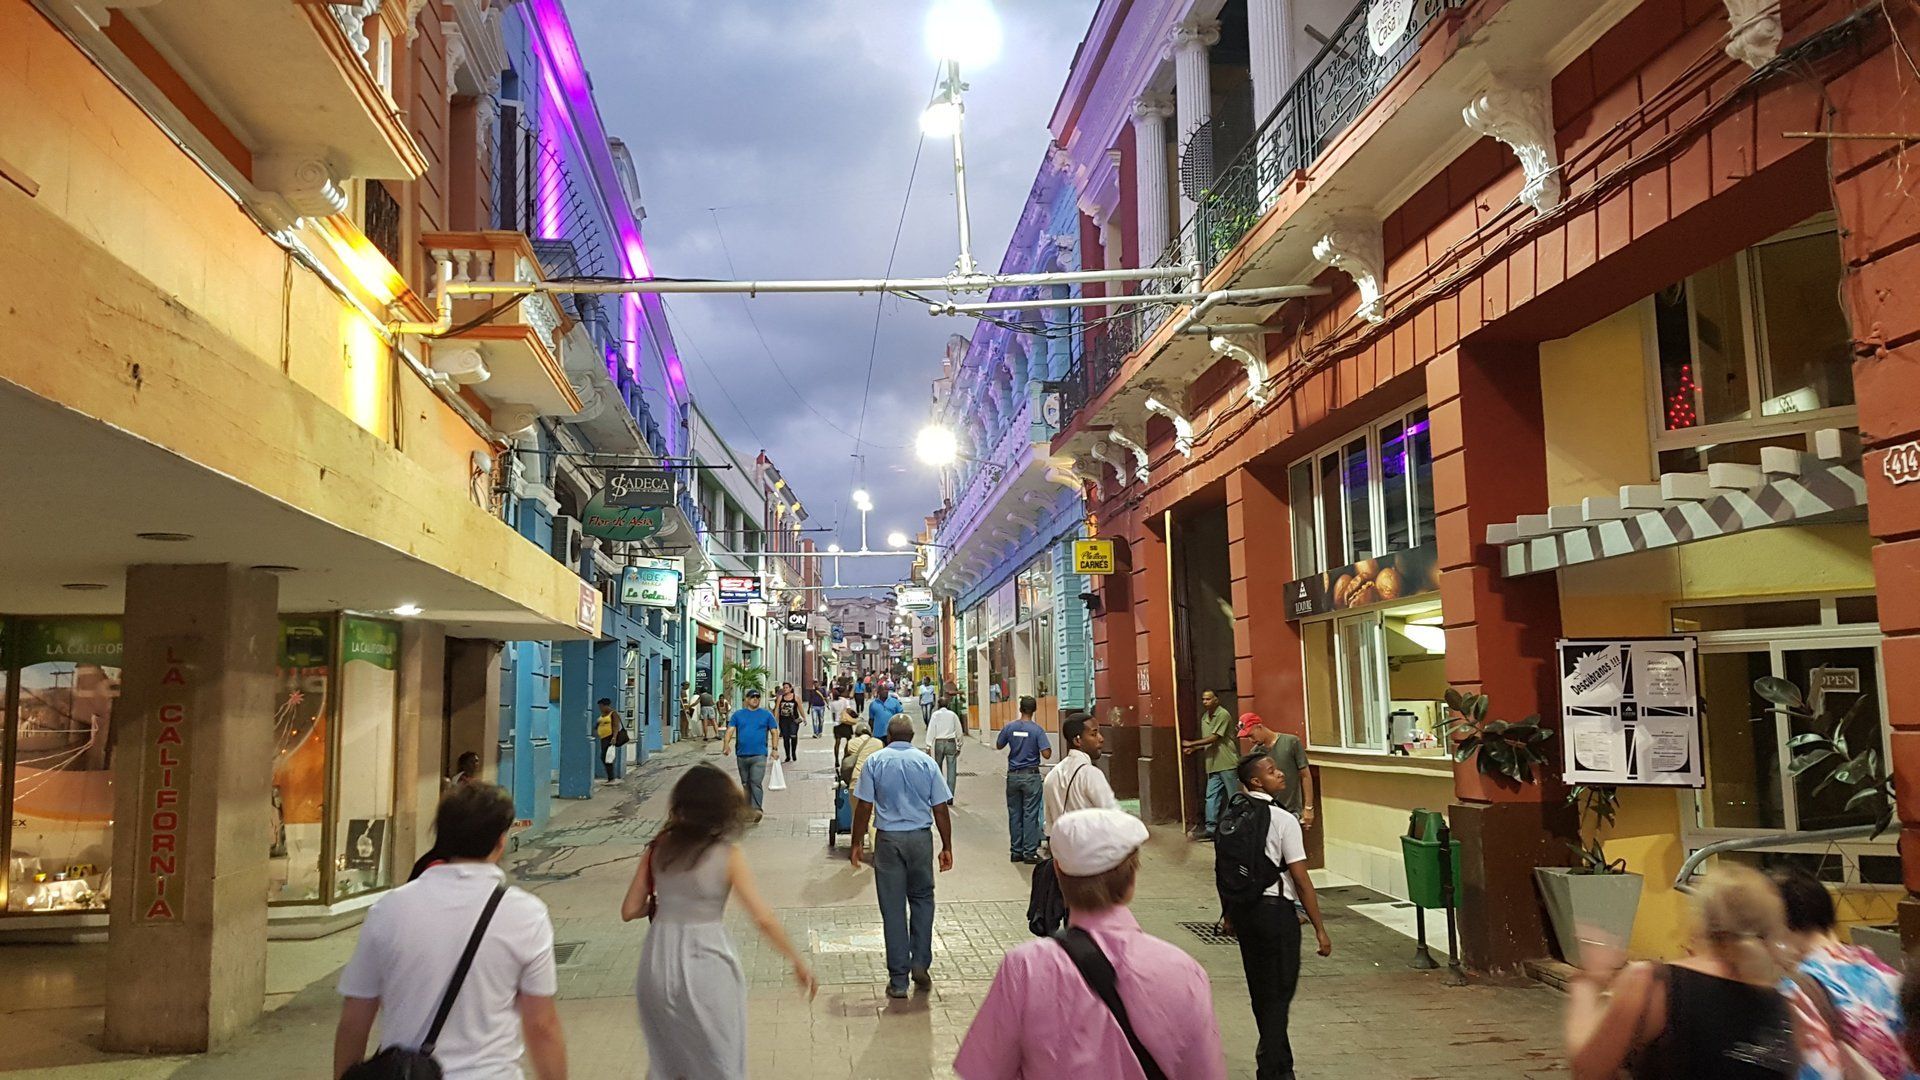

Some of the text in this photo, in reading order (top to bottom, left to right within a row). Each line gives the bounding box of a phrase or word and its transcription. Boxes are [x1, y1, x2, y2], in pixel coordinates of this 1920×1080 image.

[588, 515, 610, 526] Flor
[628, 516, 653, 528] Asia
[789, 614, 806, 625] ON
[46, 644, 64, 655] LA
[352, 642, 360, 652] LA
[162, 646, 186, 686] LA
[146, 703, 184, 919] CALIFORNIA
